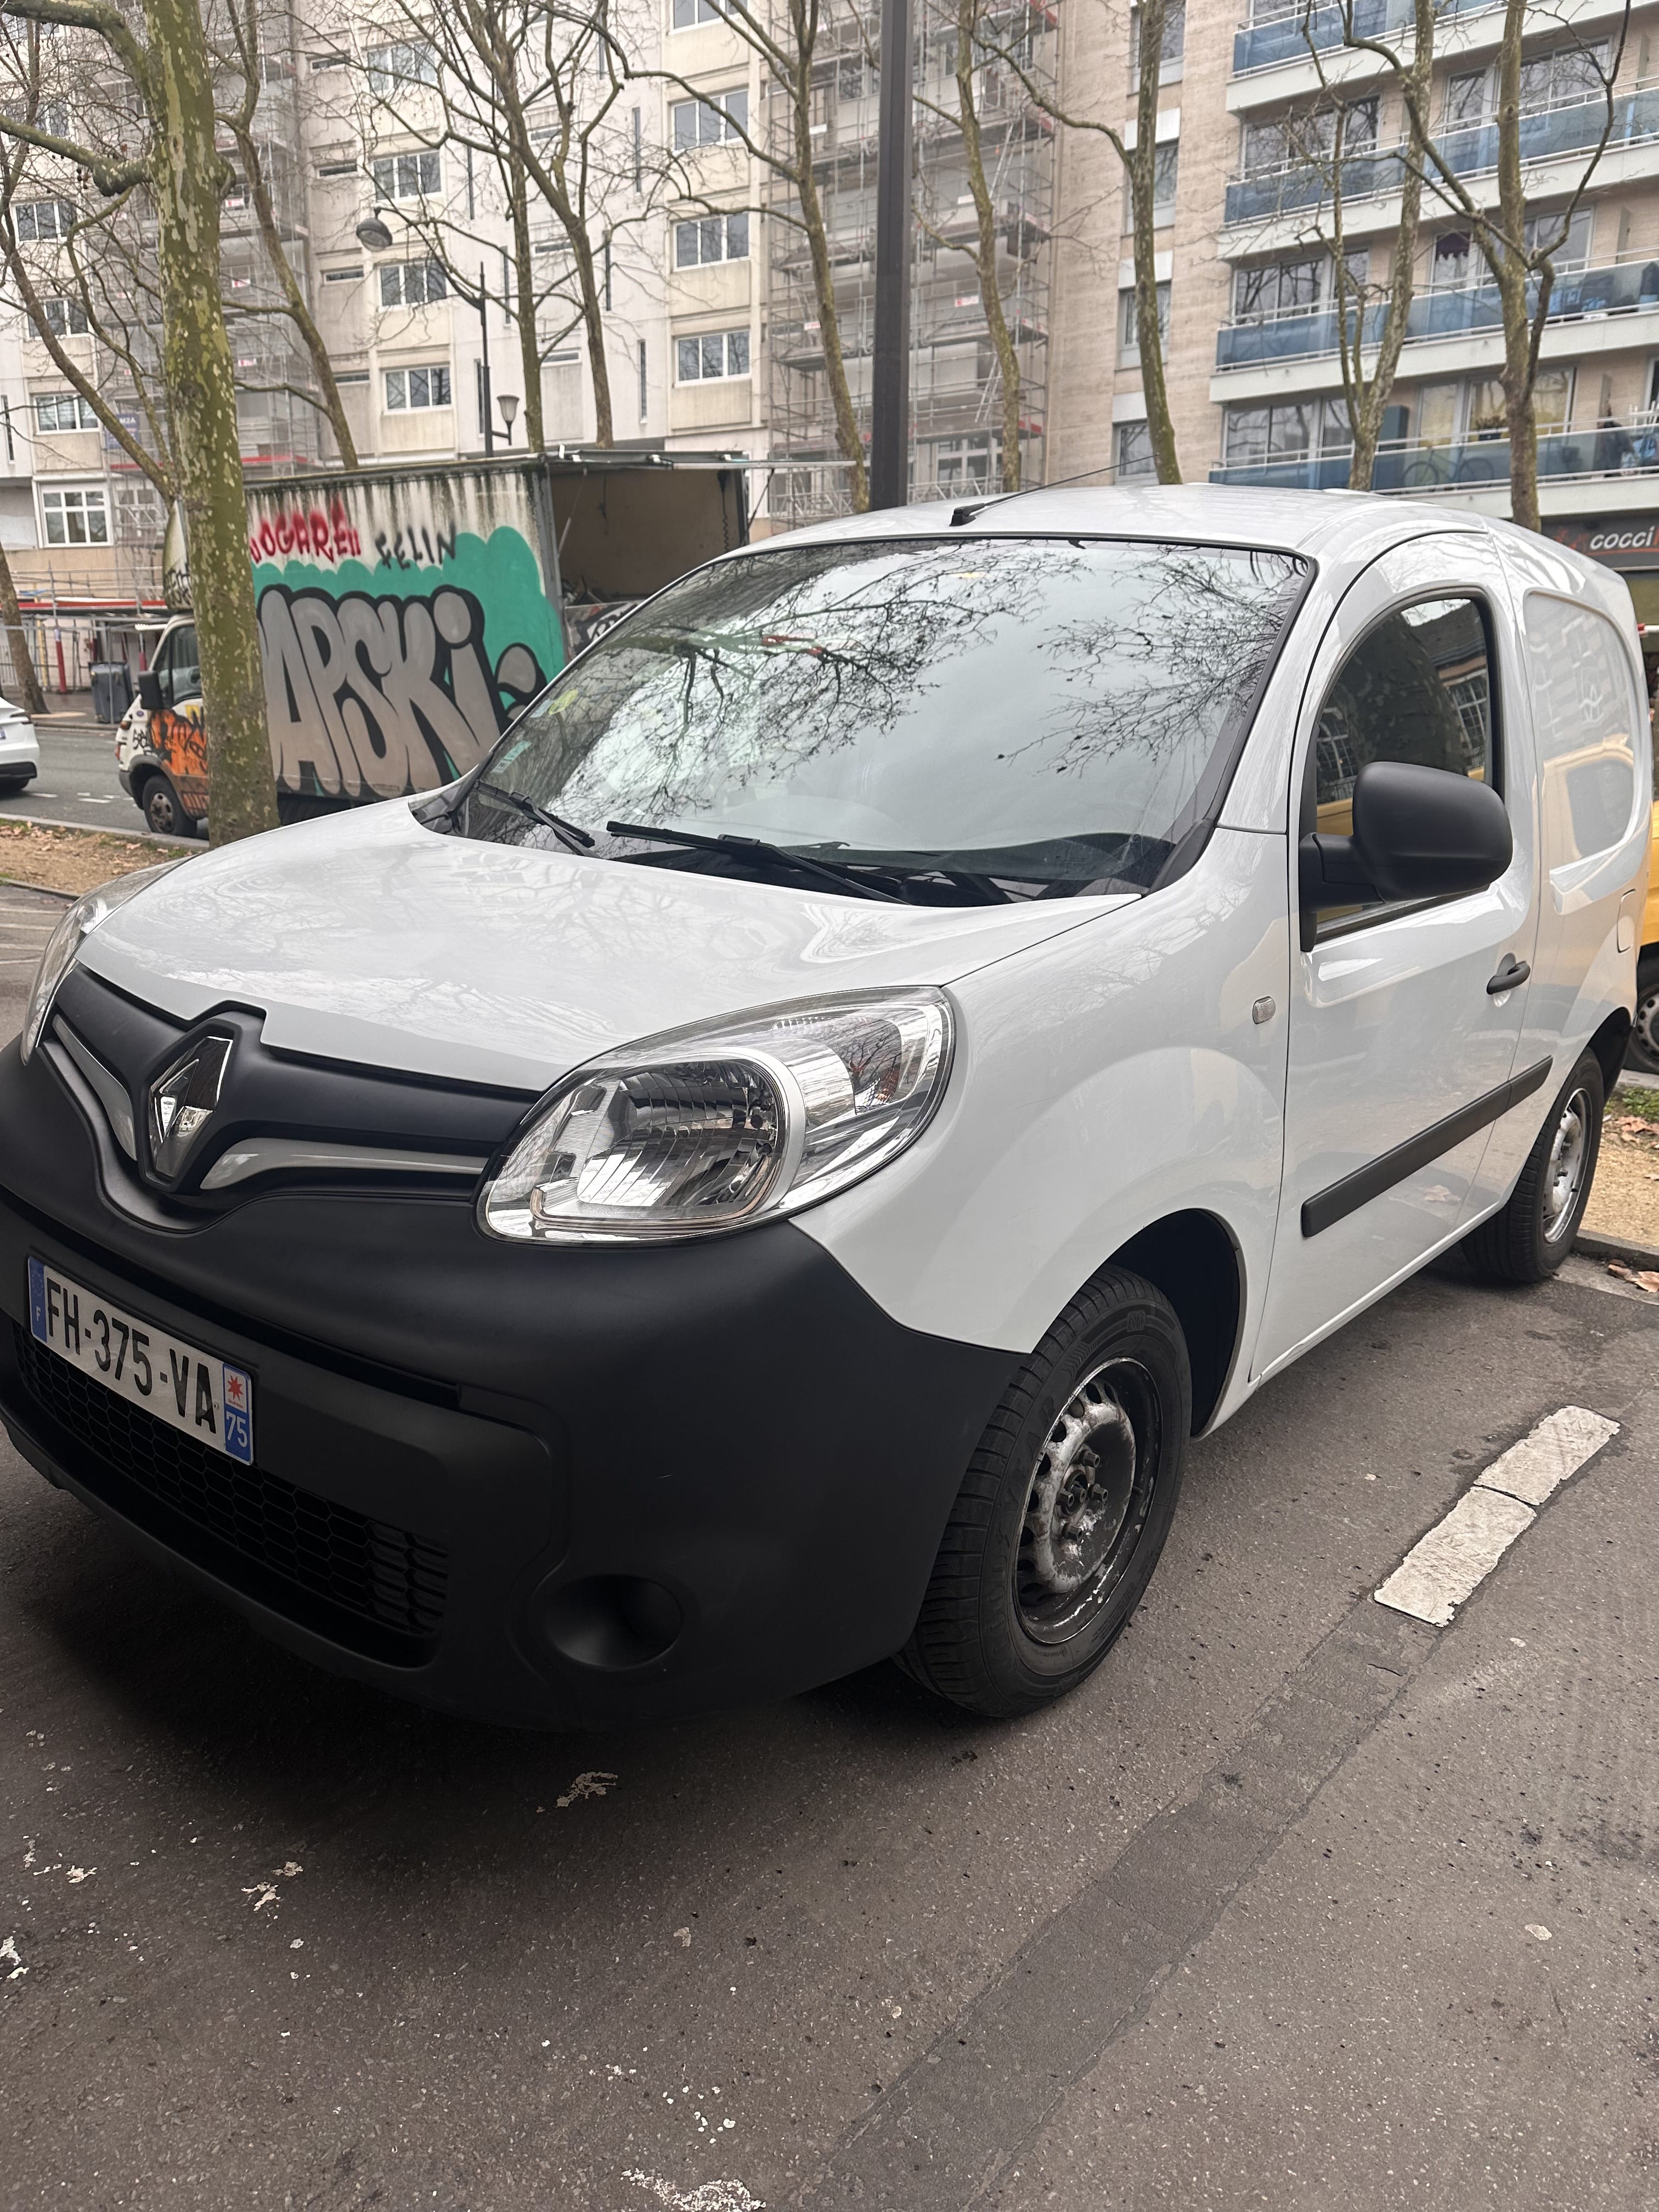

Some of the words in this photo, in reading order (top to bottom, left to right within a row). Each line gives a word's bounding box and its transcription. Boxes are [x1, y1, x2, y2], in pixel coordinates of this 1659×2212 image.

[36, 1306, 41, 1322] F
[46, 1277, 217, 1435] FH-375-VA
[225, 1413, 248, 1448] 75
